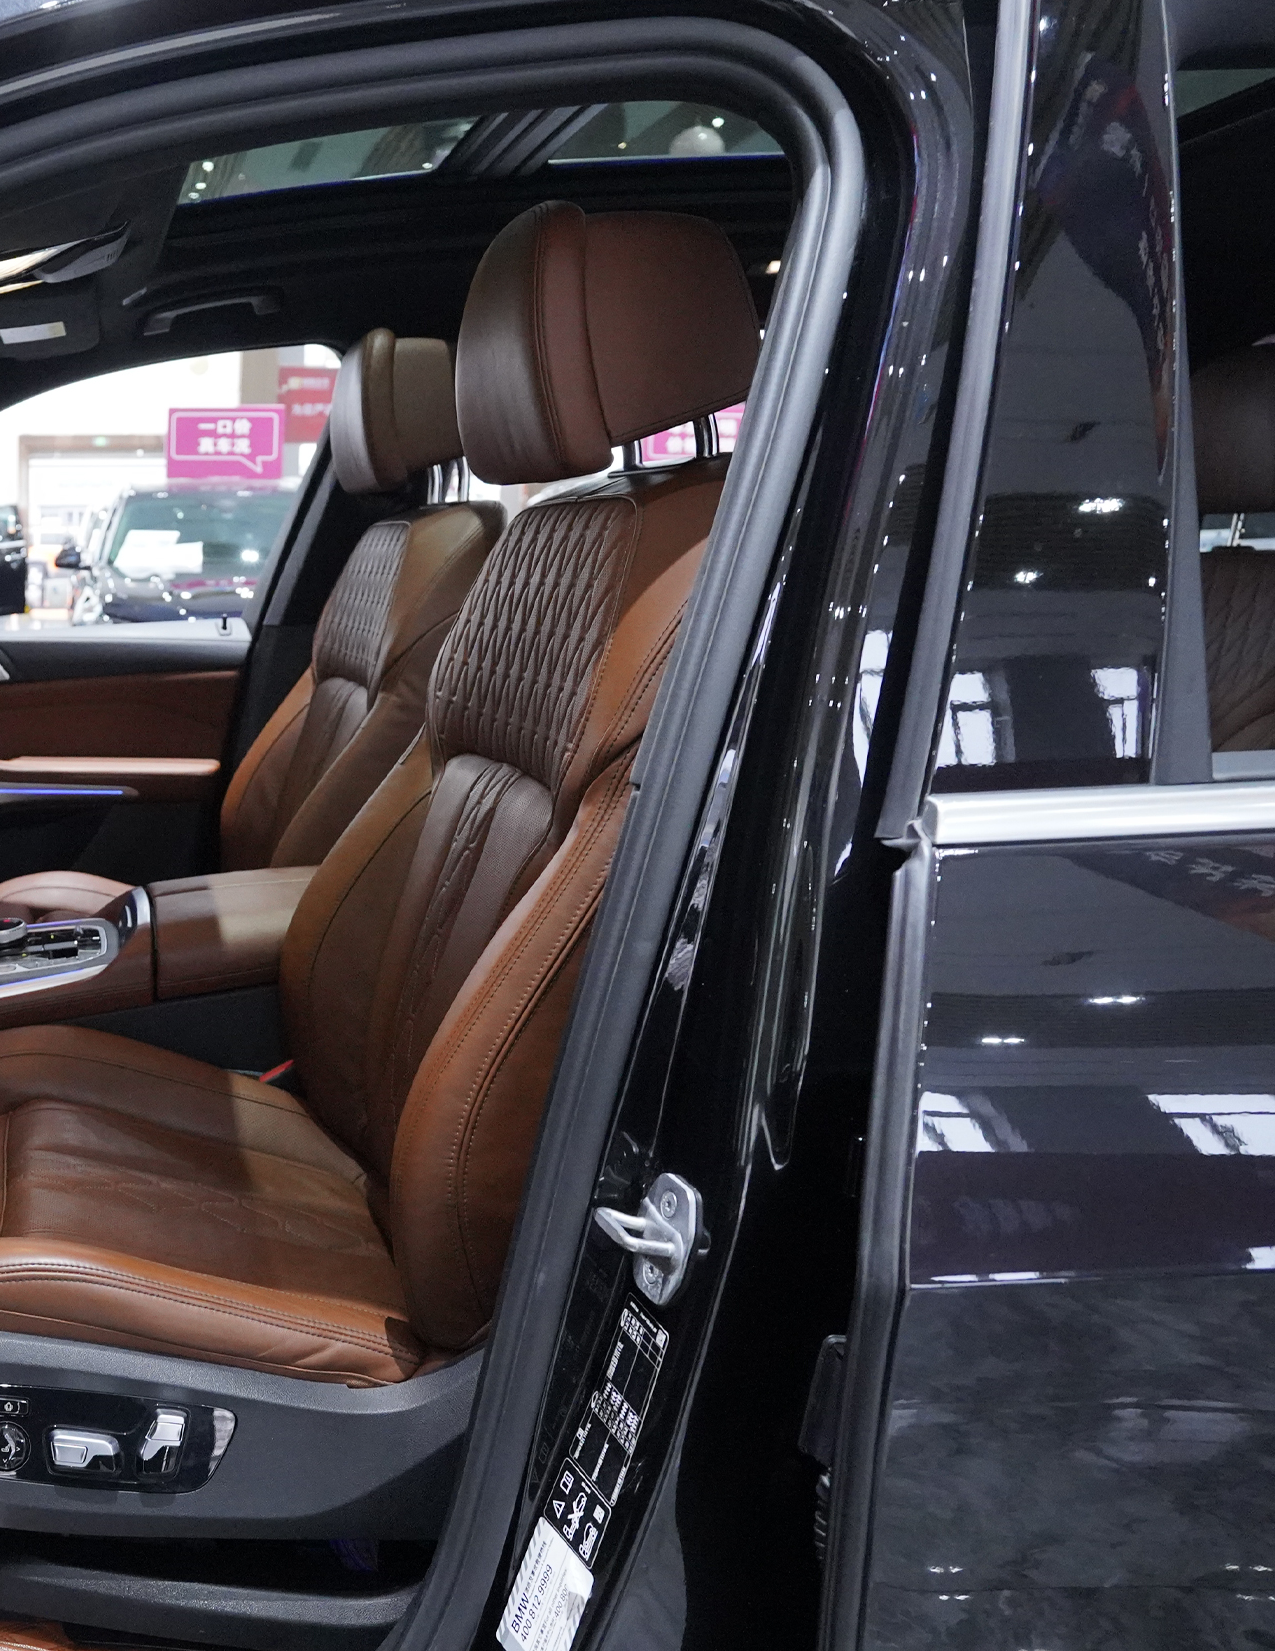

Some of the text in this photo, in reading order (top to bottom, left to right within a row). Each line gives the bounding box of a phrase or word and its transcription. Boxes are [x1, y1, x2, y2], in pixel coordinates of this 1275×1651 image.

[197, 418, 252, 436] 一口价
[511, 1592, 530, 1634] BMW
[520, 1619, 533, 1643] 400
[528, 1594, 542, 1620] 812
[537, 1563, 553, 1596] 9999
[554, 1600, 563, 1618] 400
